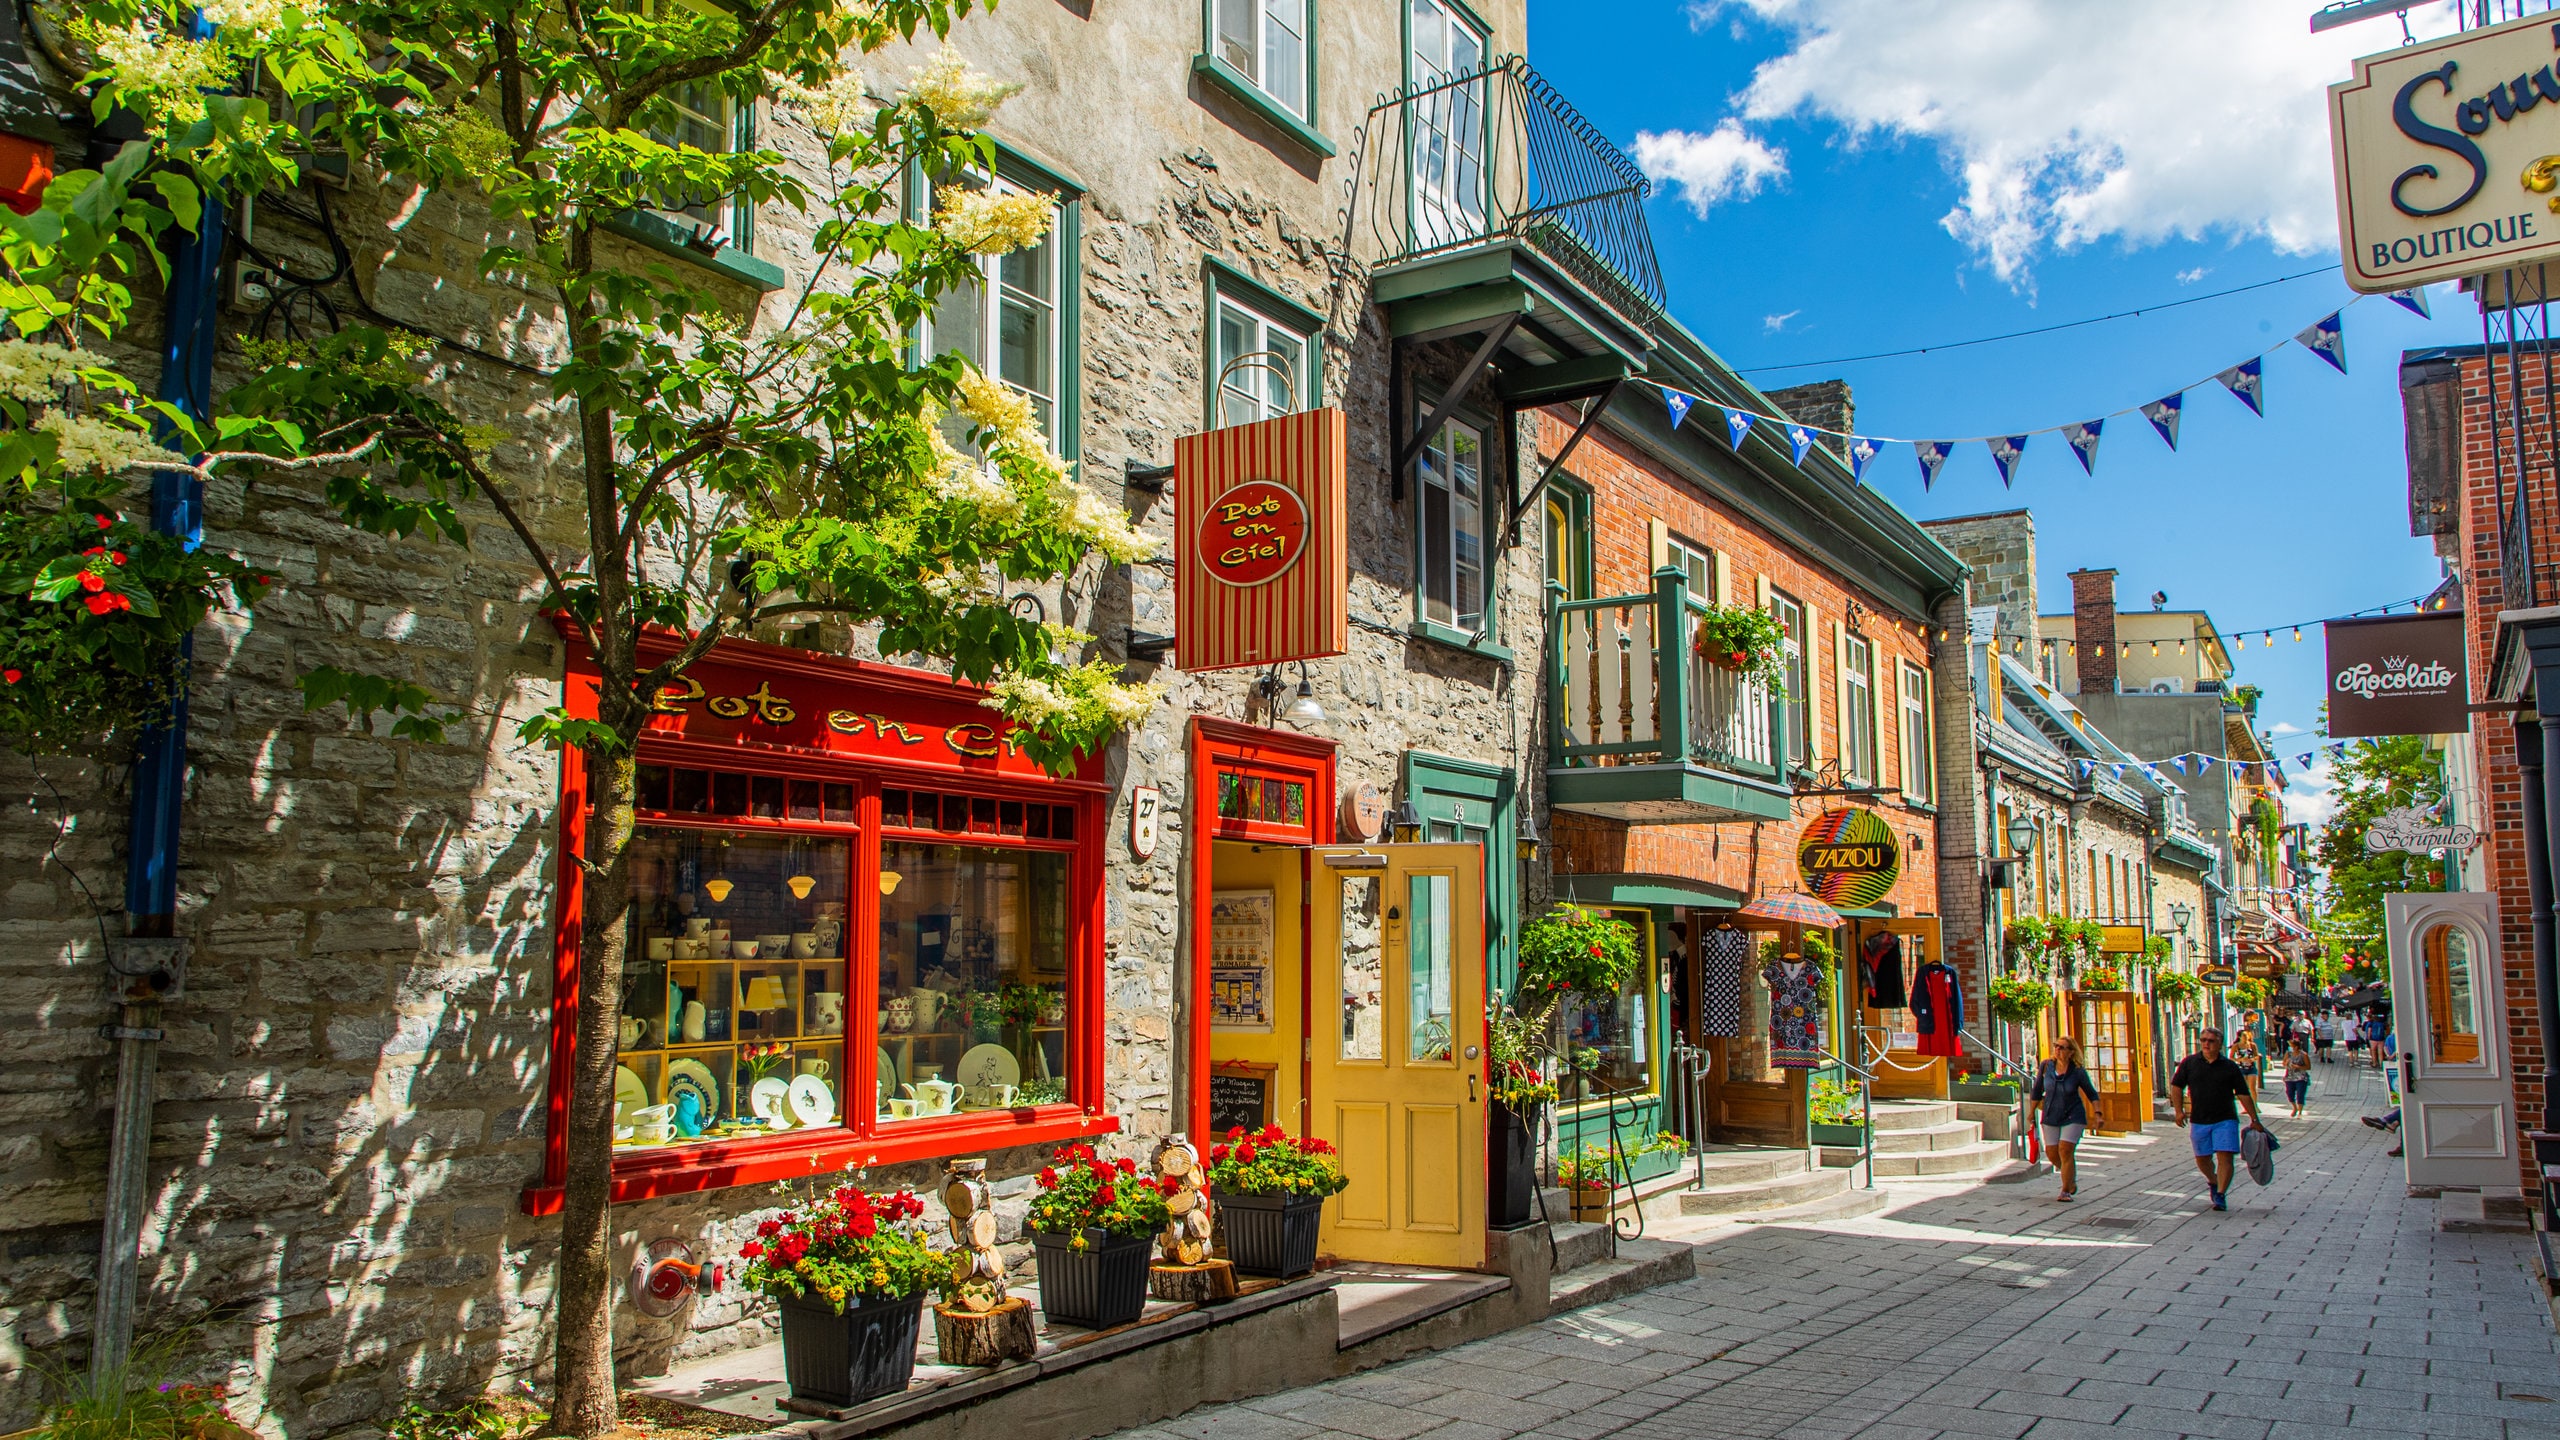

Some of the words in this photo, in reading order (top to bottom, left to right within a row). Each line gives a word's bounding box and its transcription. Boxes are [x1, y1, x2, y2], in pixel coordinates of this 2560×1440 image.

[2372, 213, 2538, 268] BOUTIQUE
[1219, 494, 1281, 523] Pot
[1232, 523, 1277, 538] en
[1219, 535, 1286, 566] Ciel
[2335, 660, 2458, 699] Chocolato
[634, 668, 797, 725] Pot
[827, 709, 925, 744] en
[944, 722, 1020, 758] Ci
[1139, 798, 1156, 819] 27
[1454, 803, 1465, 821] 29
[2368, 828, 2470, 852] Scrupules
[1814, 847, 1881, 869] ZAZOU
